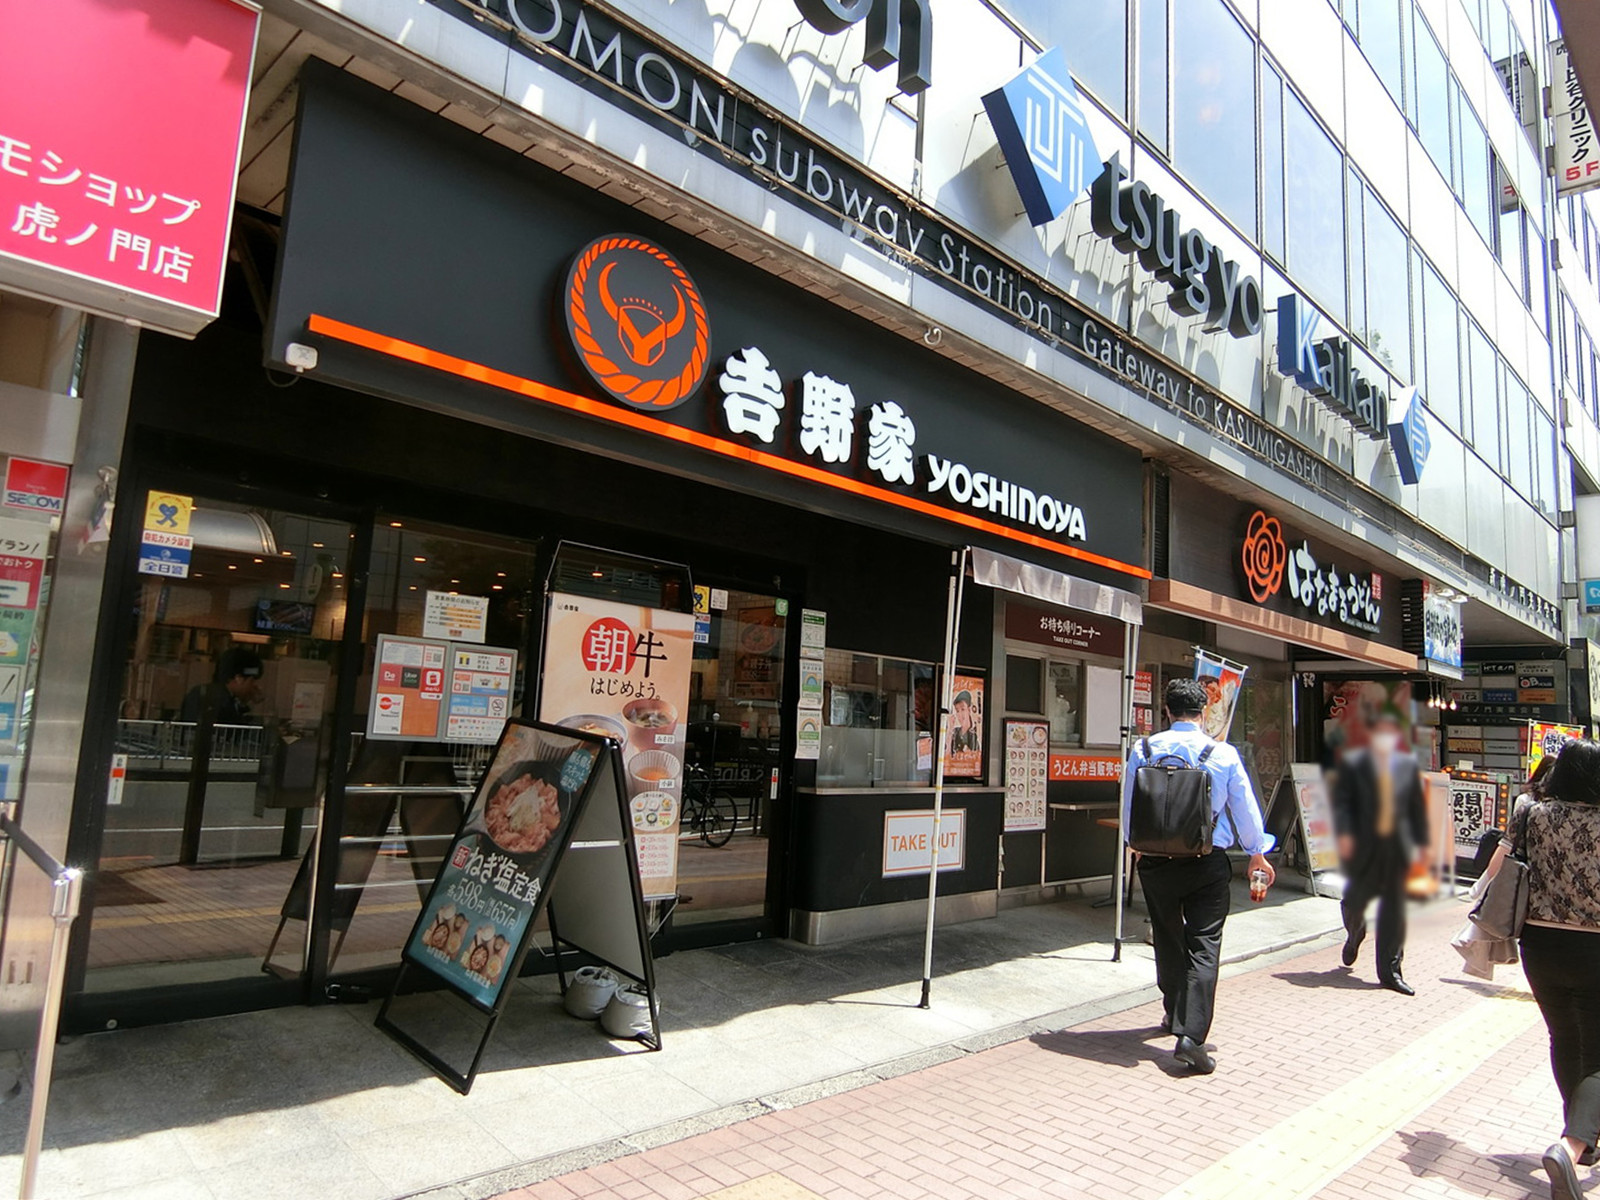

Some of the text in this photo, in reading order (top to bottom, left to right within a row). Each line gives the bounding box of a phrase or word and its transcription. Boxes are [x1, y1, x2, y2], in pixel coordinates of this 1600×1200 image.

[11, 201, 195, 284] 虎ノ門店
[478, 0, 1323, 487] OMON subway Station Gateway to KASUMIGASEKI
[1092, 150, 1263, 339] tsugyo
[1278, 293, 1388, 441] Kaikan
[7, 492, 60, 510] SECOM
[1288, 540, 1380, 625] はなまるうどん
[587, 624, 668, 678] 朝牛
[1040, 616, 1101, 639] お持ち帰りコーナー
[590, 677, 661, 700] はじめよう。
[1053, 759, 1122, 777] うどん弁当販売中
[891, 833, 927, 852] TAKE
[464, 846, 541, 907] ねぎ塩定食
